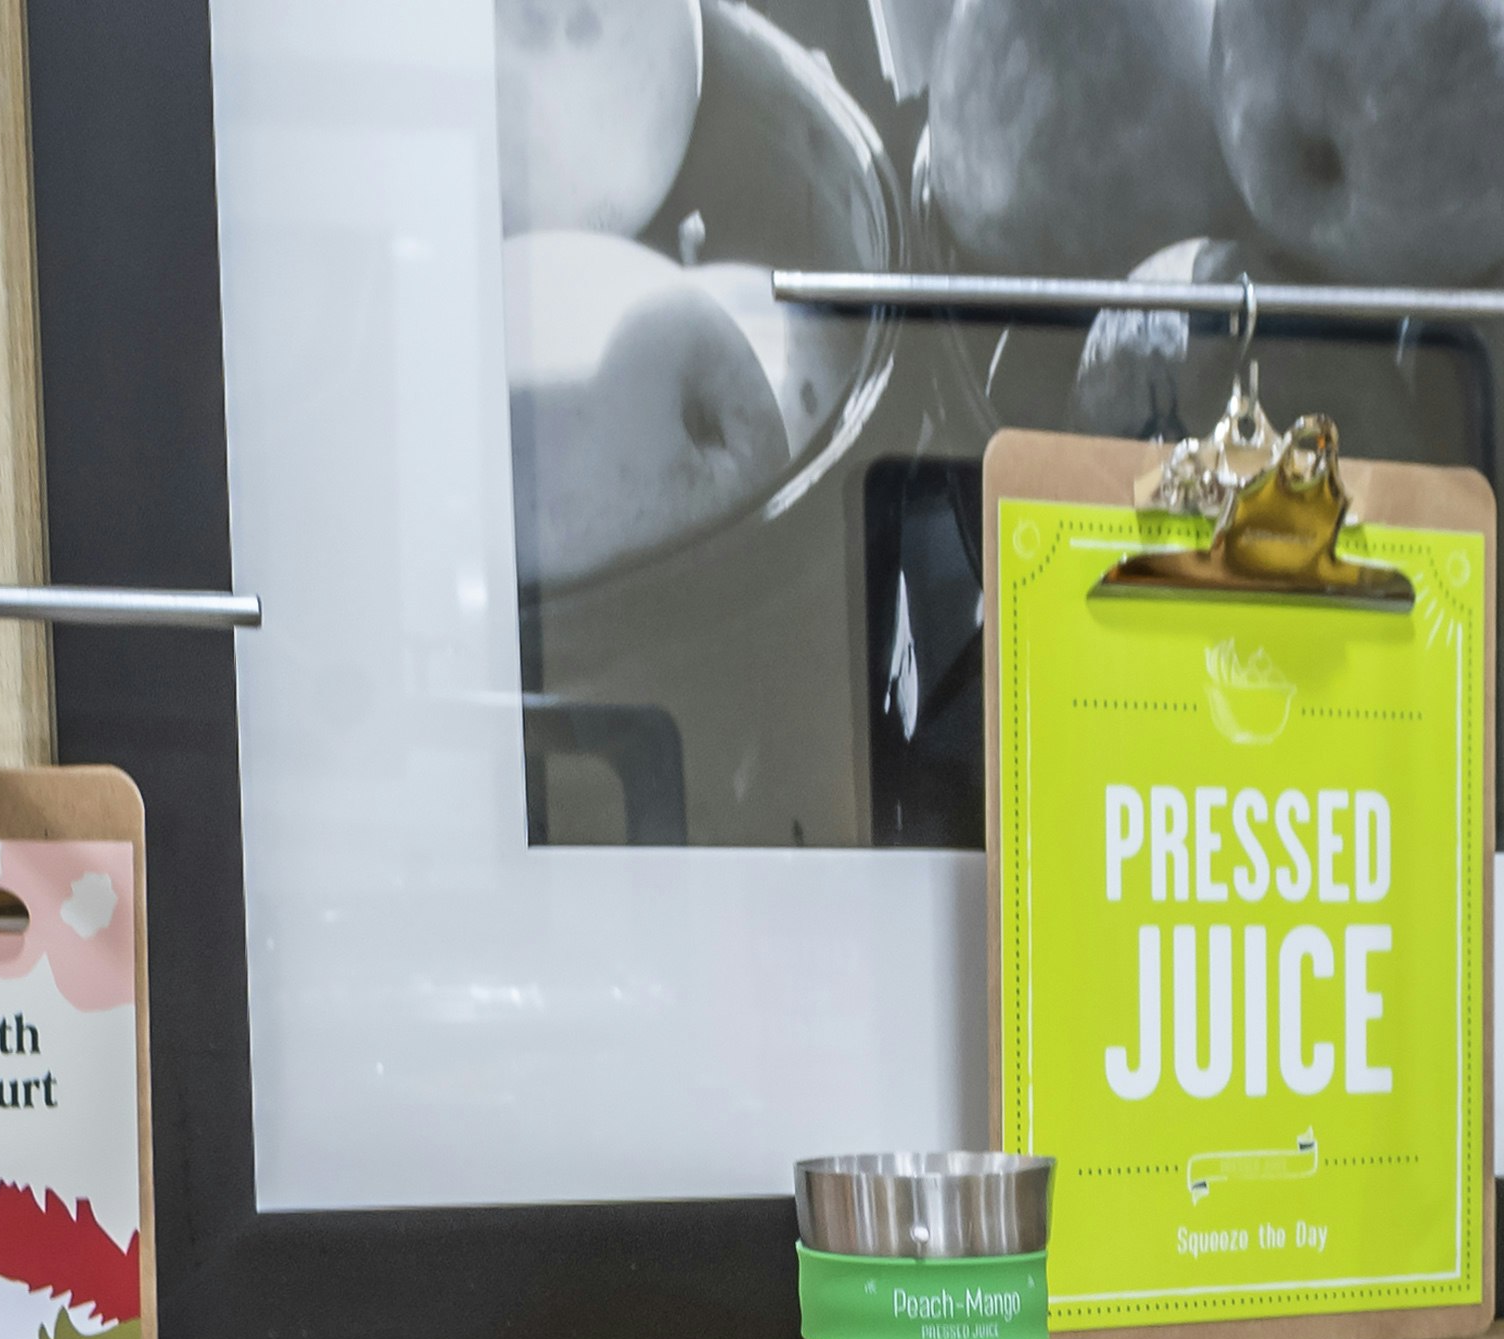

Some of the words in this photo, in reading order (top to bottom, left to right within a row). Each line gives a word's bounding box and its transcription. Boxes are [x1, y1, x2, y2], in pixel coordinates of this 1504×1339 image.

[1105, 785, 1392, 903] PRESSED
[1105, 923, 1393, 1101] JUICE
[1177, 1226, 1249, 1259] Squeeze
[1259, 1222, 1286, 1249] the
[1295, 1220, 1328, 1253] Day
[893, 1286, 1021, 1322] Peach-Mango
[971, 1323, 999, 1339] JUICE
